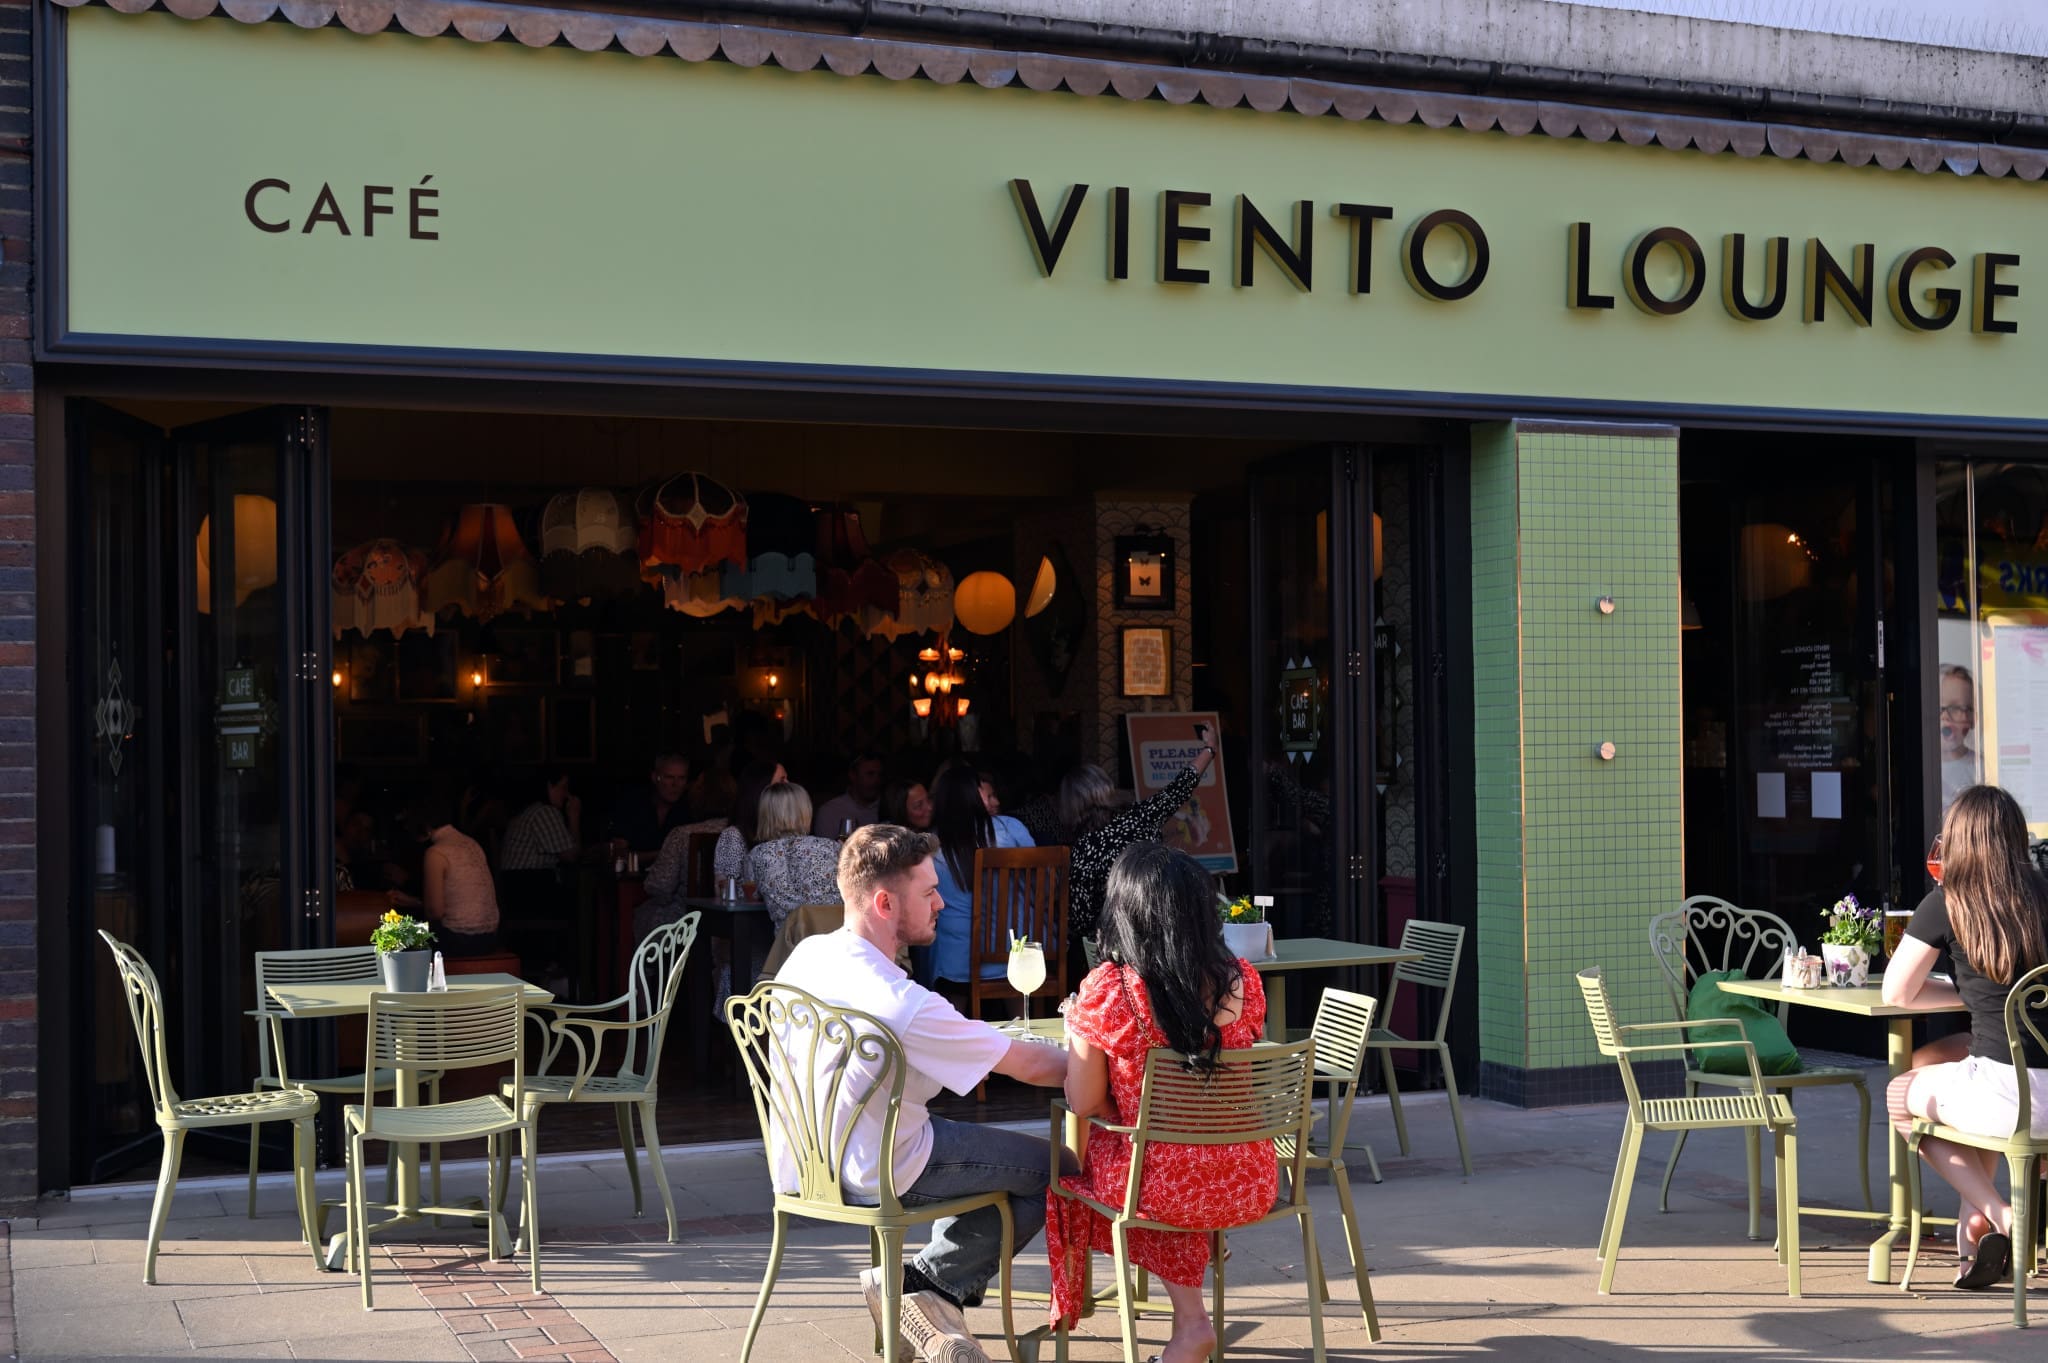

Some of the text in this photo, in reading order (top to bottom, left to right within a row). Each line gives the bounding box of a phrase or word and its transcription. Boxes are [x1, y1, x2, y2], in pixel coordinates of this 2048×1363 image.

[244, 175, 440, 240] CAFÉ
[1009, 178, 2021, 334] VIENTO LOUNGE
[228, 672, 251, 697] CAFÉ
[1292, 713, 1306, 729] BAR
[231, 740, 249, 761] BAR
[1150, 760, 1183, 770] WAIT
